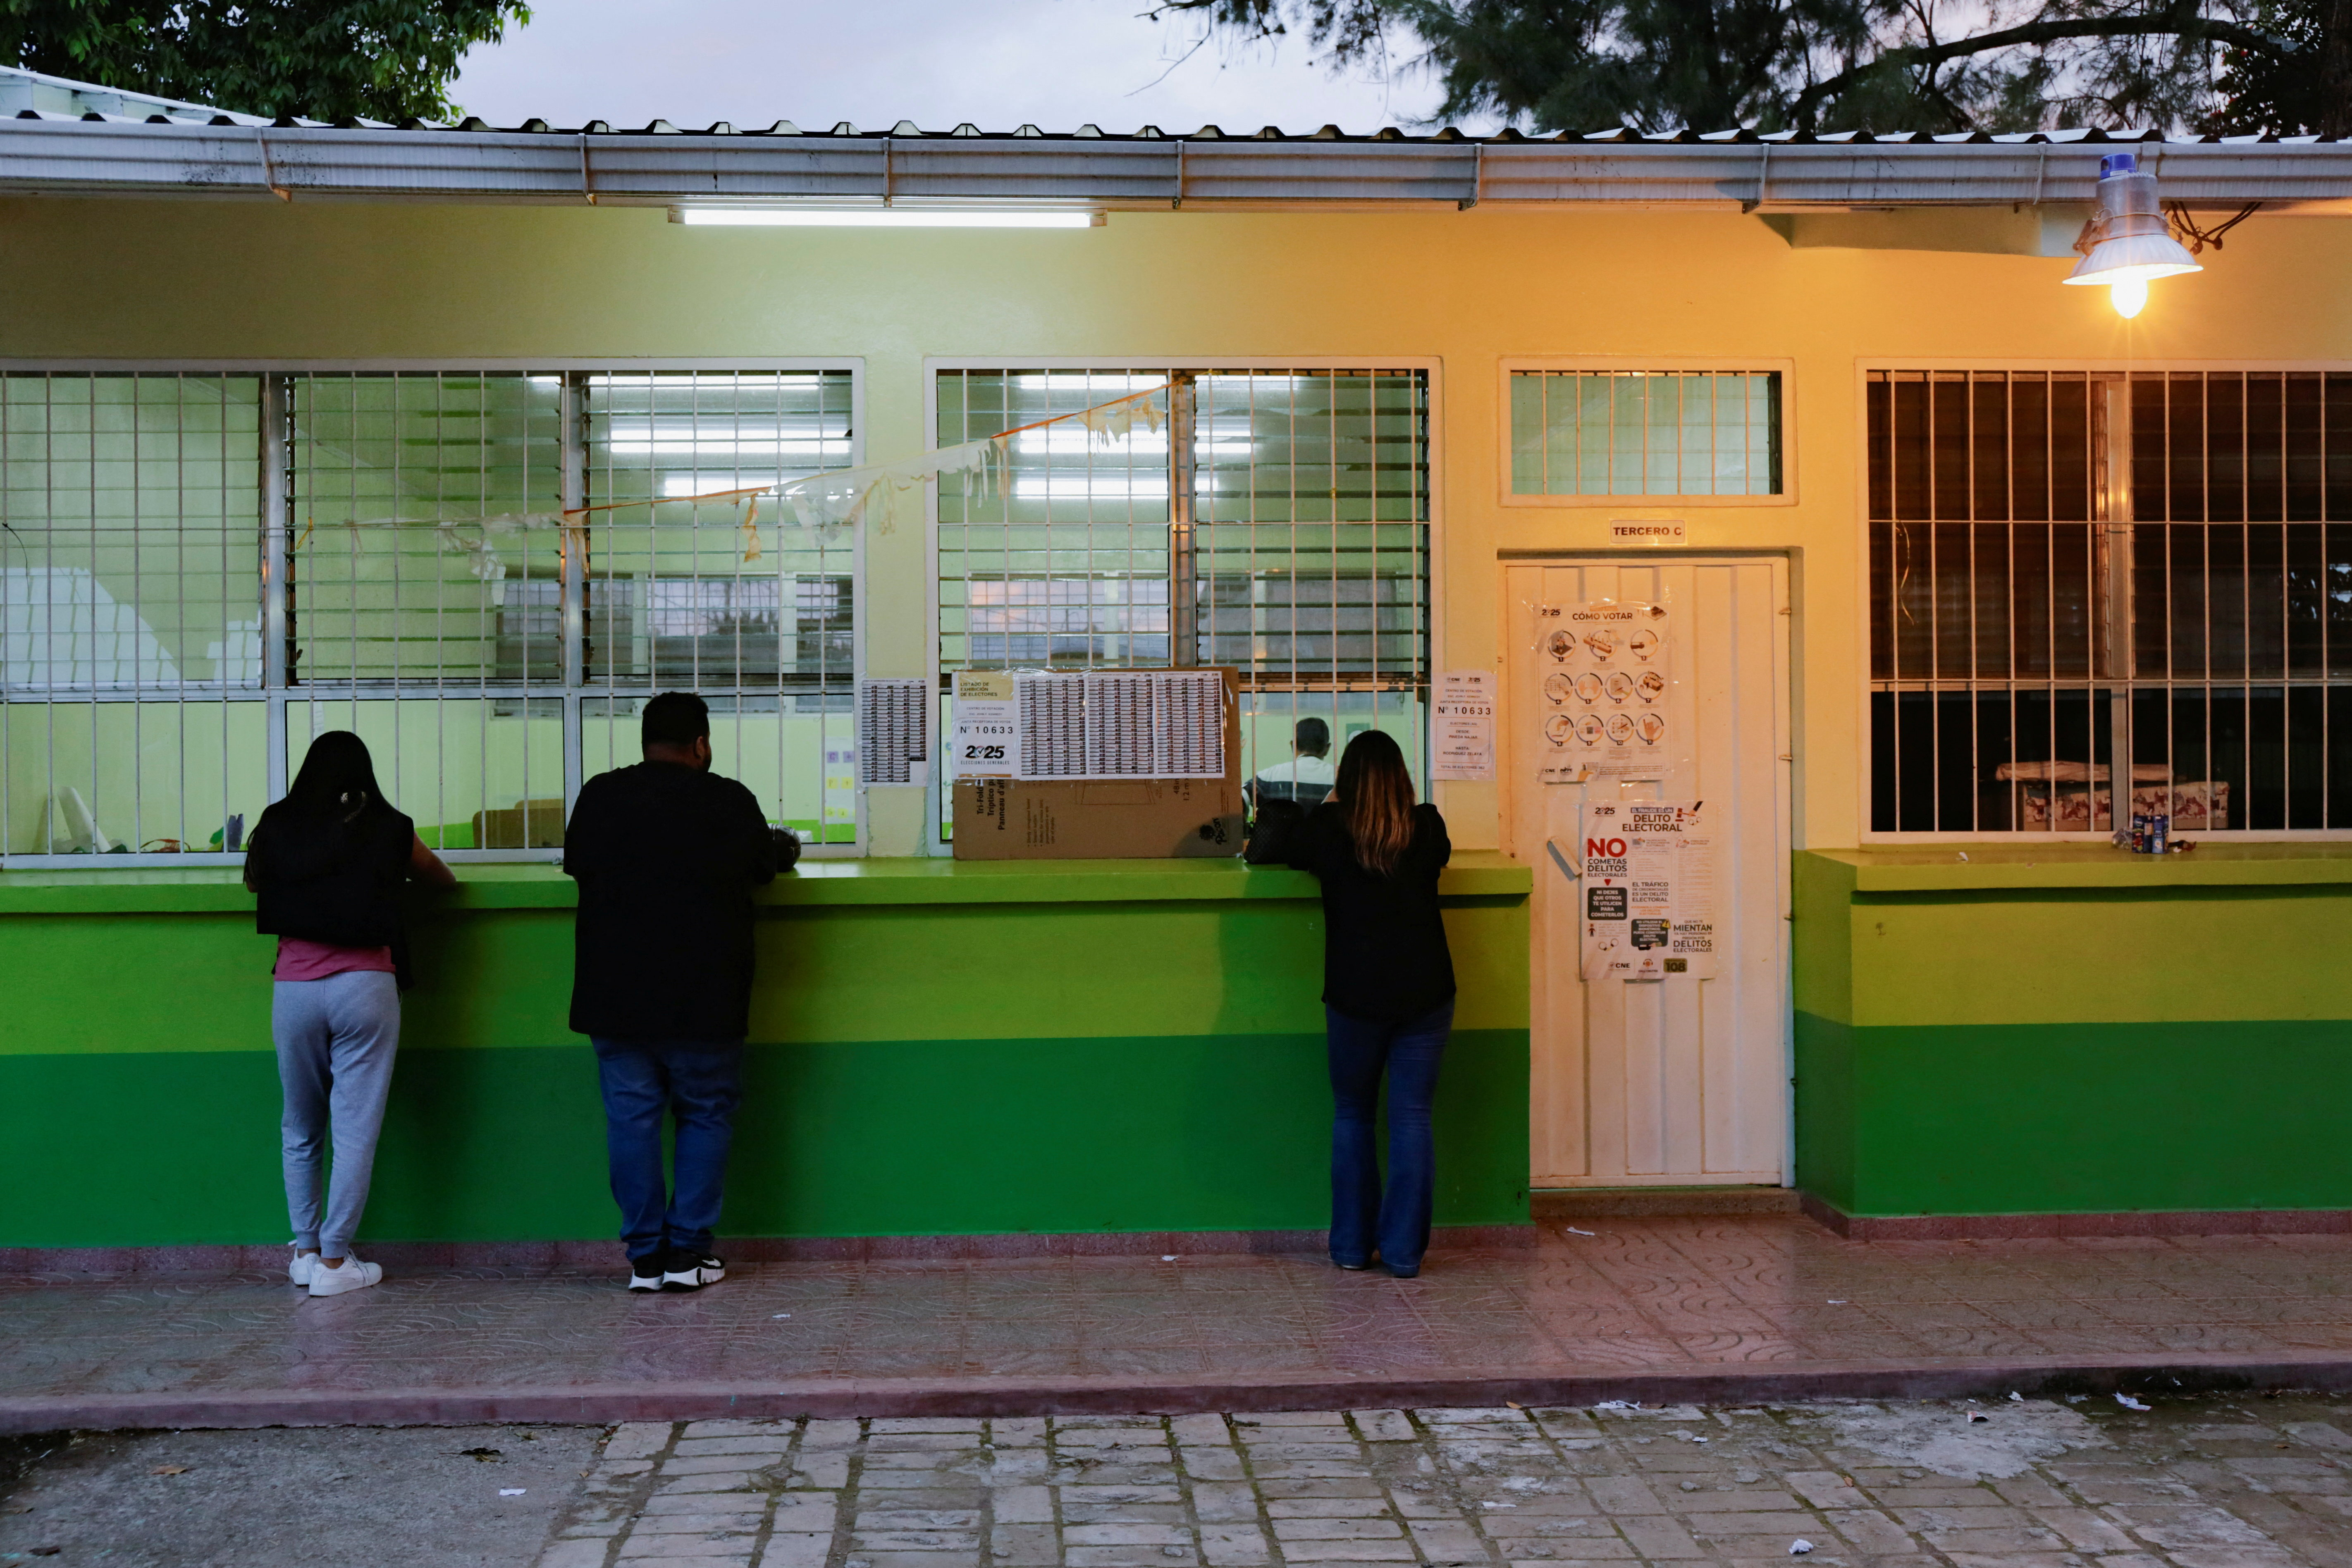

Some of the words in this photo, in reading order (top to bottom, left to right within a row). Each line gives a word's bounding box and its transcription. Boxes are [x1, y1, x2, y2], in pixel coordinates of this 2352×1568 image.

[1613, 527, 1669, 535] TERCERO
[1674, 527, 1682, 535] C
[1572, 611, 1600, 620] CÓMO
[965, 745, 1005, 759] 2025
[1174, 786, 1180, 794] 48
[1588, 838, 1627, 857] NO
[1666, 962, 1686, 971] 108
